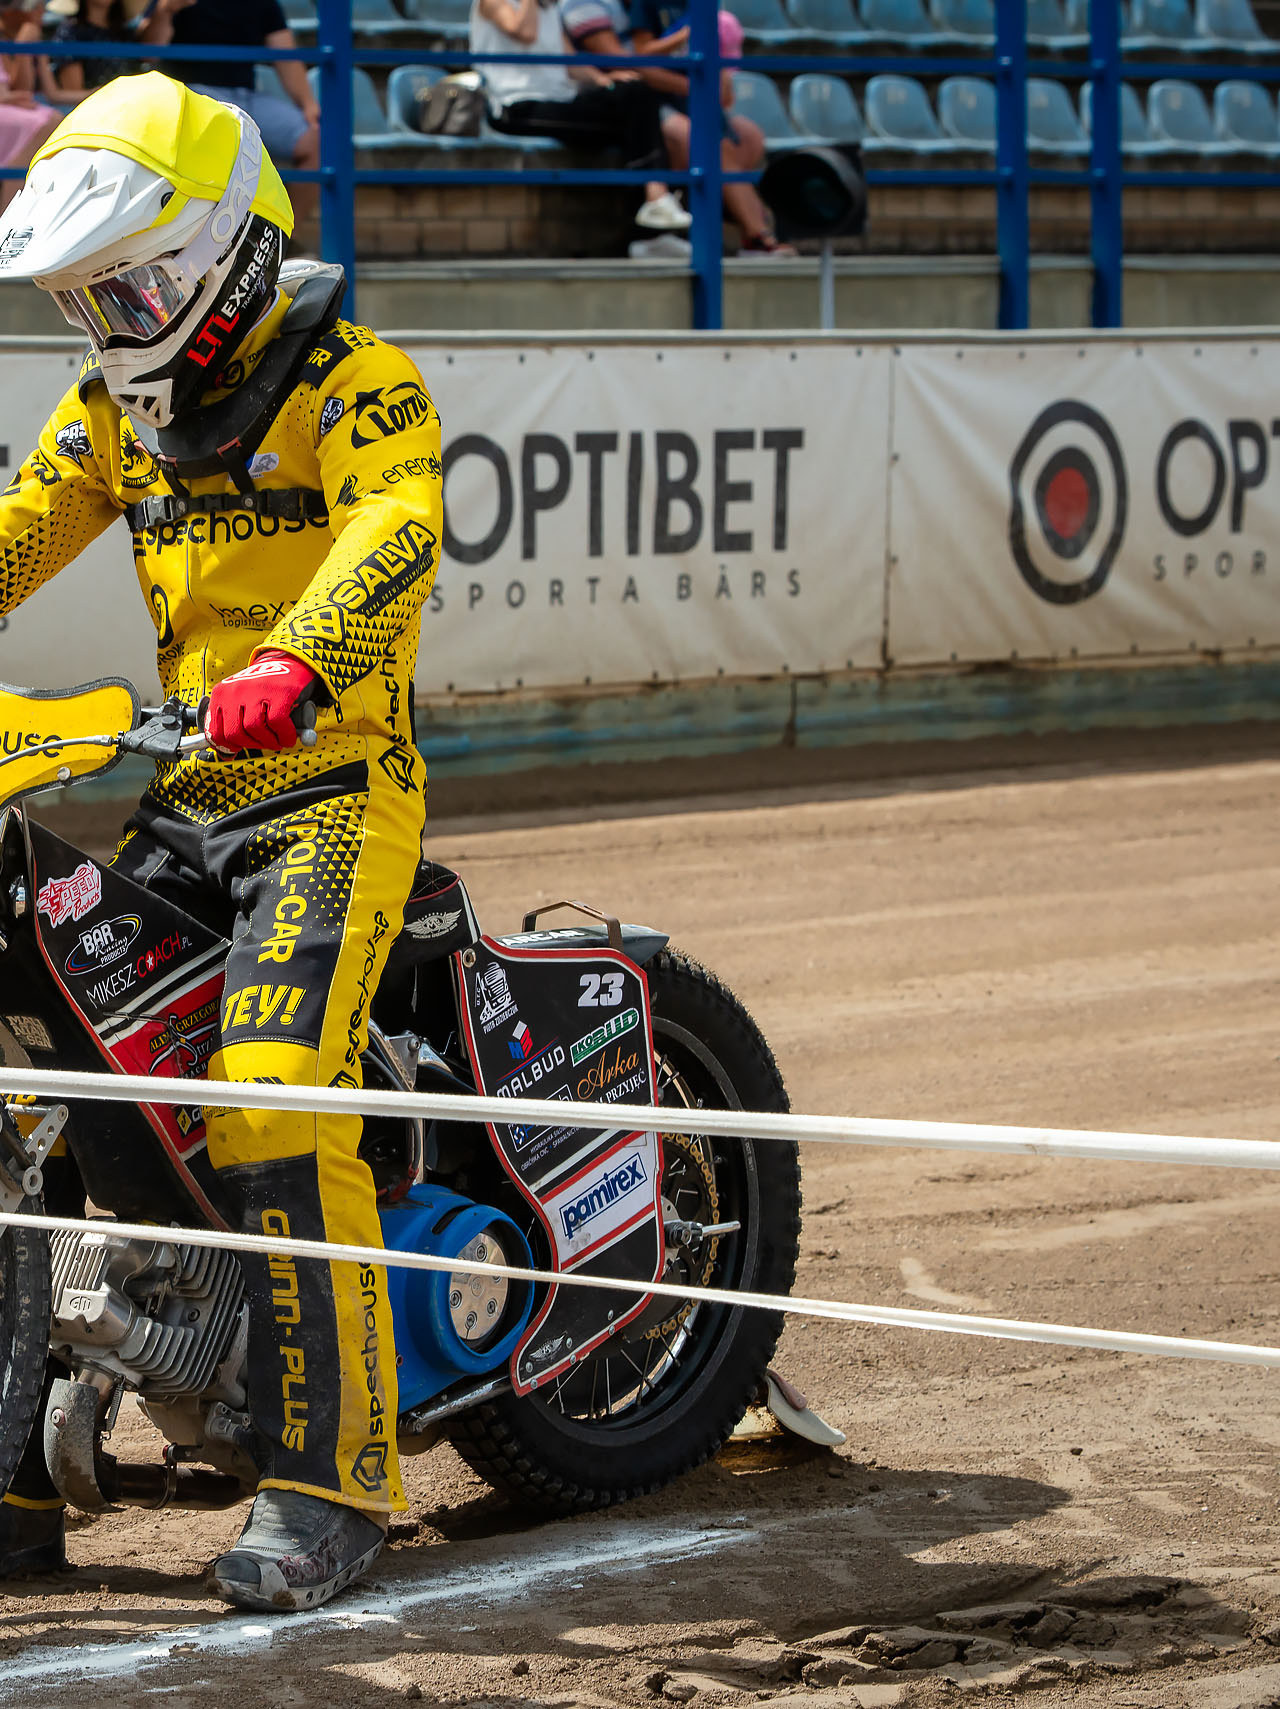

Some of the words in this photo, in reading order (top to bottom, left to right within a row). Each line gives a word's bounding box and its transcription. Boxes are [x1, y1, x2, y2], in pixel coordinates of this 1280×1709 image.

[220, 226, 274, 319] EXPRESS
[186, 312, 240, 368] LTL
[366, 392, 428, 438] LOTTO
[441, 427, 806, 565] OPTIBET
[1156, 416, 1280, 538] OP
[429, 576, 641, 613] SPORTA
[675, 565, 802, 601] BĀRS
[48, 871, 96, 913] SPEED
[257, 820, 320, 965] POL-CAR
[81, 922, 115, 957] BAR
[577, 972, 625, 1007] 23
[576, 1045, 640, 1101] Arka
[562, 1159, 646, 1240] pamirex
